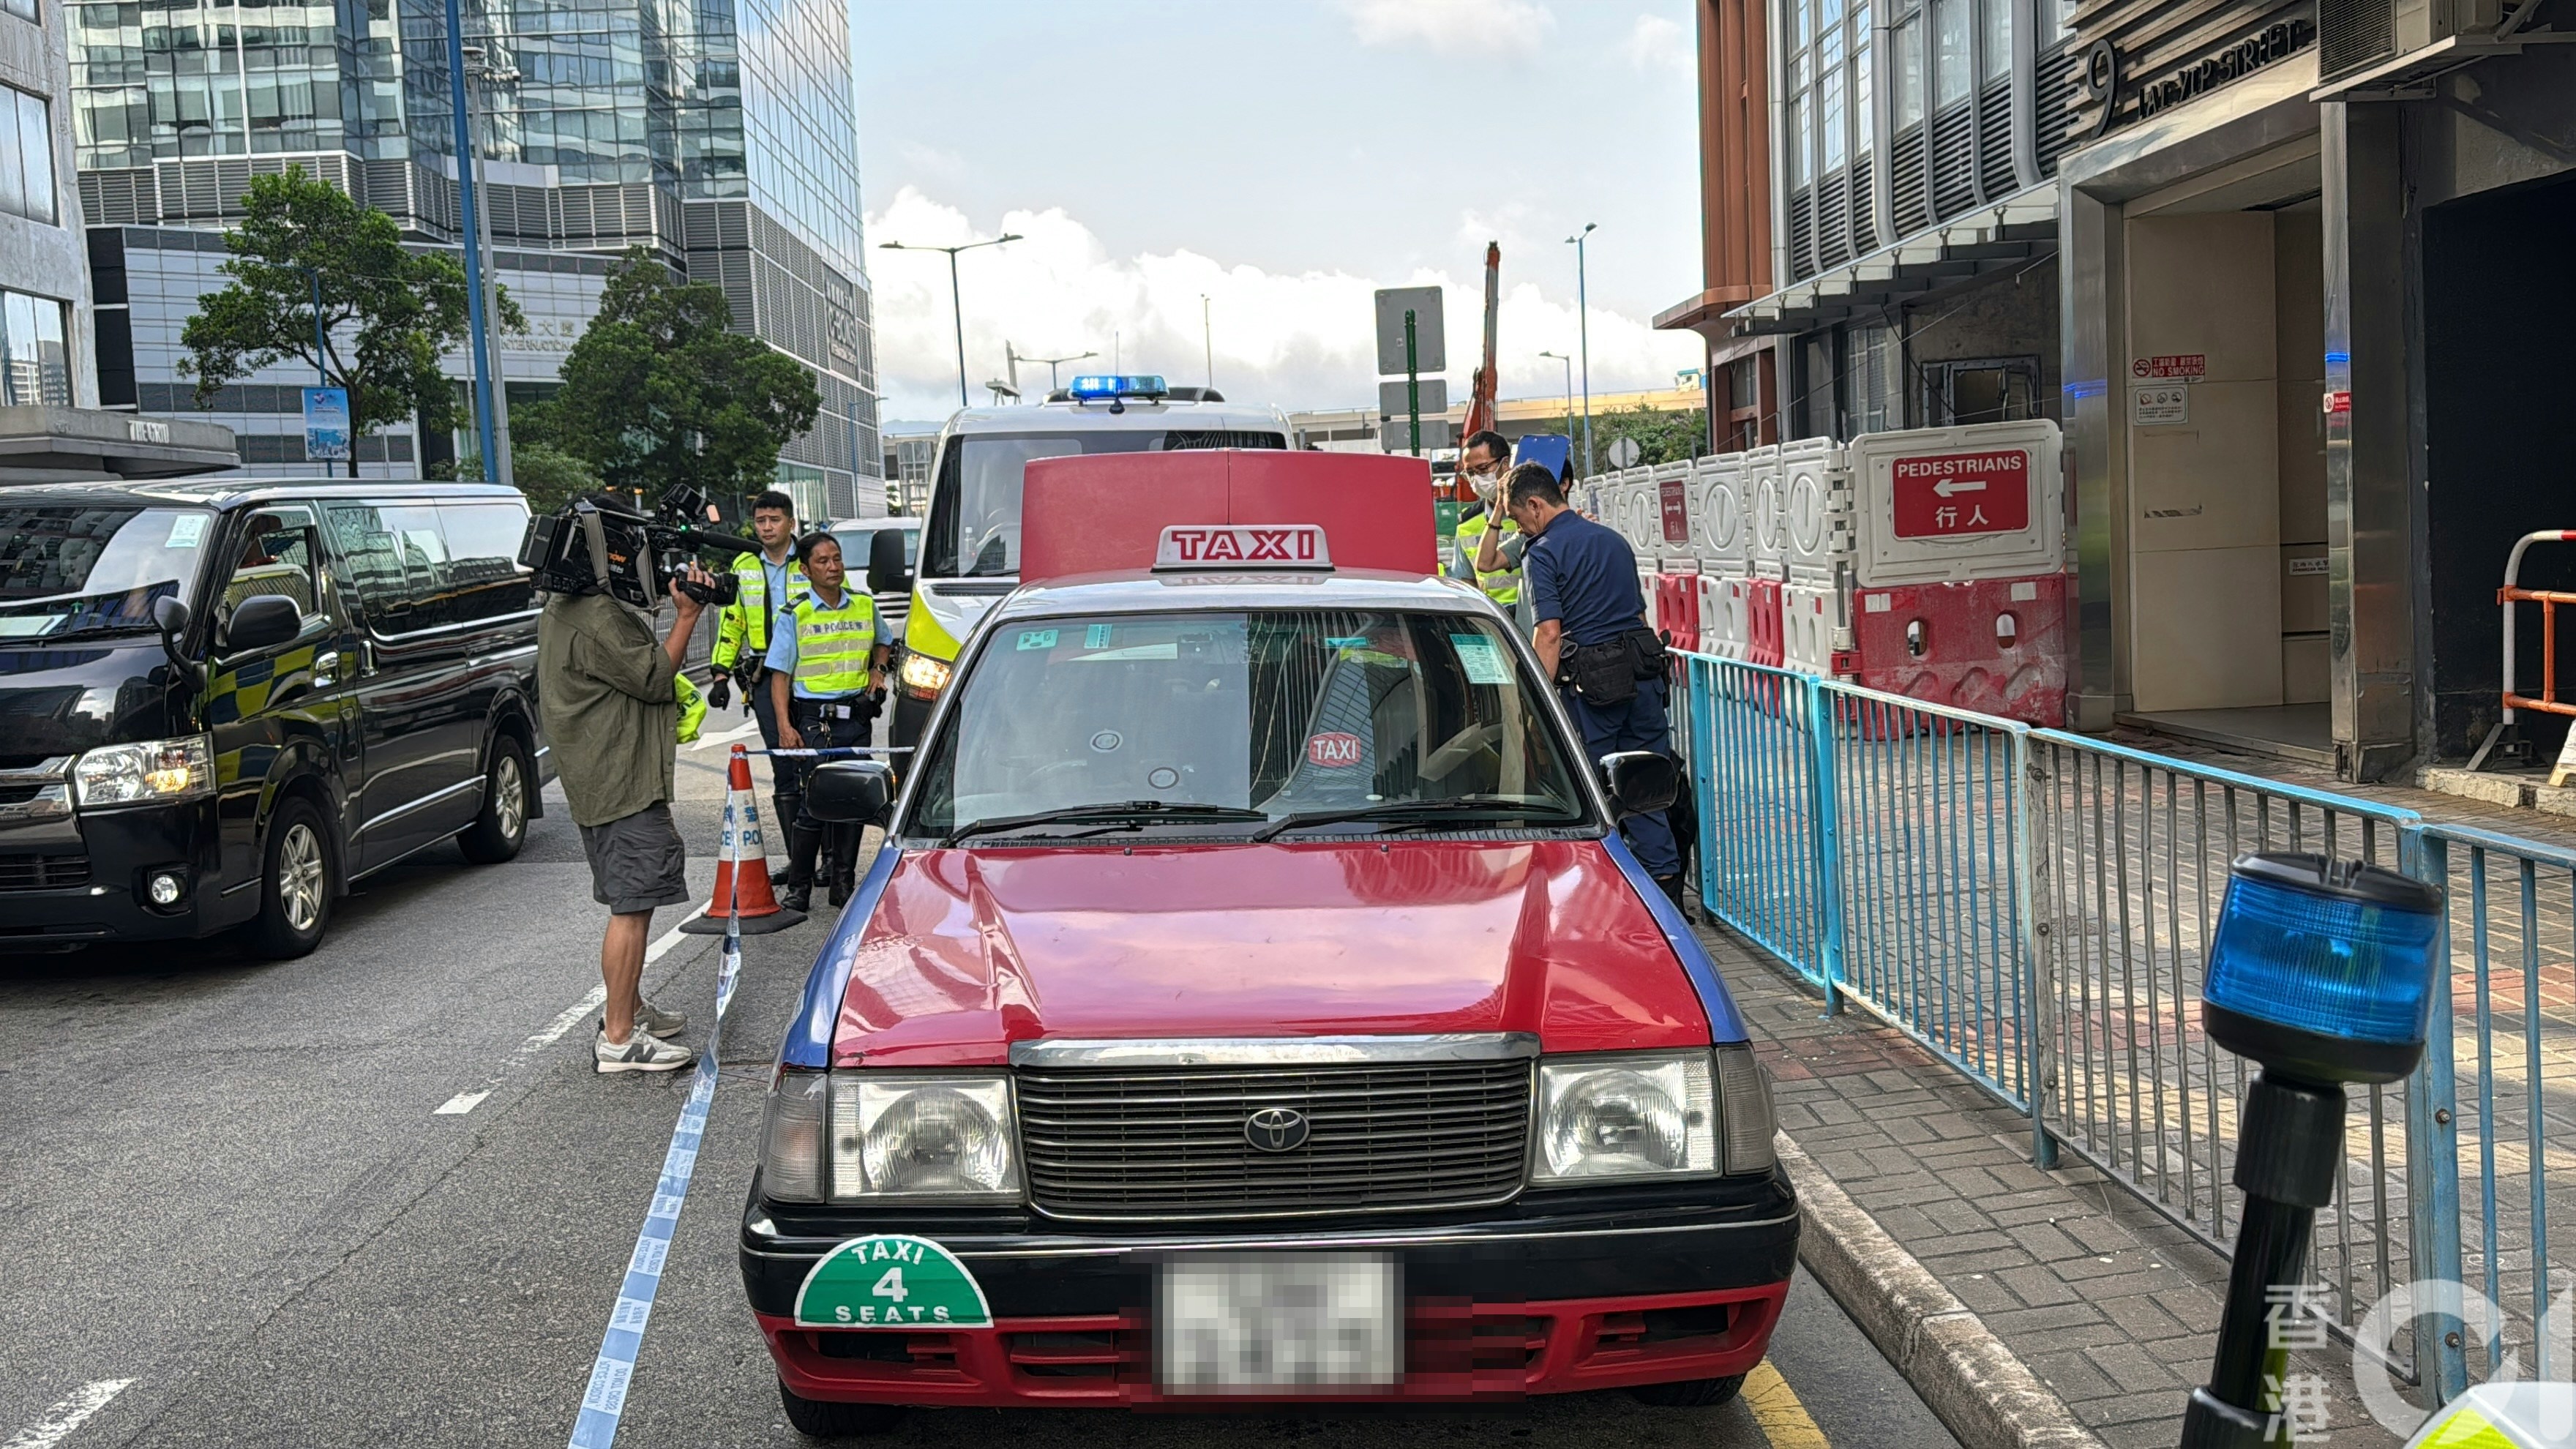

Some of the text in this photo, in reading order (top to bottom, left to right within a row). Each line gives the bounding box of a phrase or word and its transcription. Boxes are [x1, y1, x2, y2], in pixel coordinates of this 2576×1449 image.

[2178, 59, 2213, 102] YIP
[2217, 20, 2299, 83] STREET
[2086, 39, 2117, 139] 9
[2153, 366, 2204, 376] NO SMOKING
[127, 420, 170, 443] THE GRID
[1898, 456, 2021, 478] PEDESTRIANS
[1936, 504, 1990, 528] 行人
[1172, 531, 1314, 560] TAXI
[824, 621, 854, 632] POLICE
[1314, 740, 1356, 760] TAXI
[851, 1240, 924, 1265] TAXI
[872, 1267, 908, 1303] 4
[835, 1306, 950, 1322] SEATS
